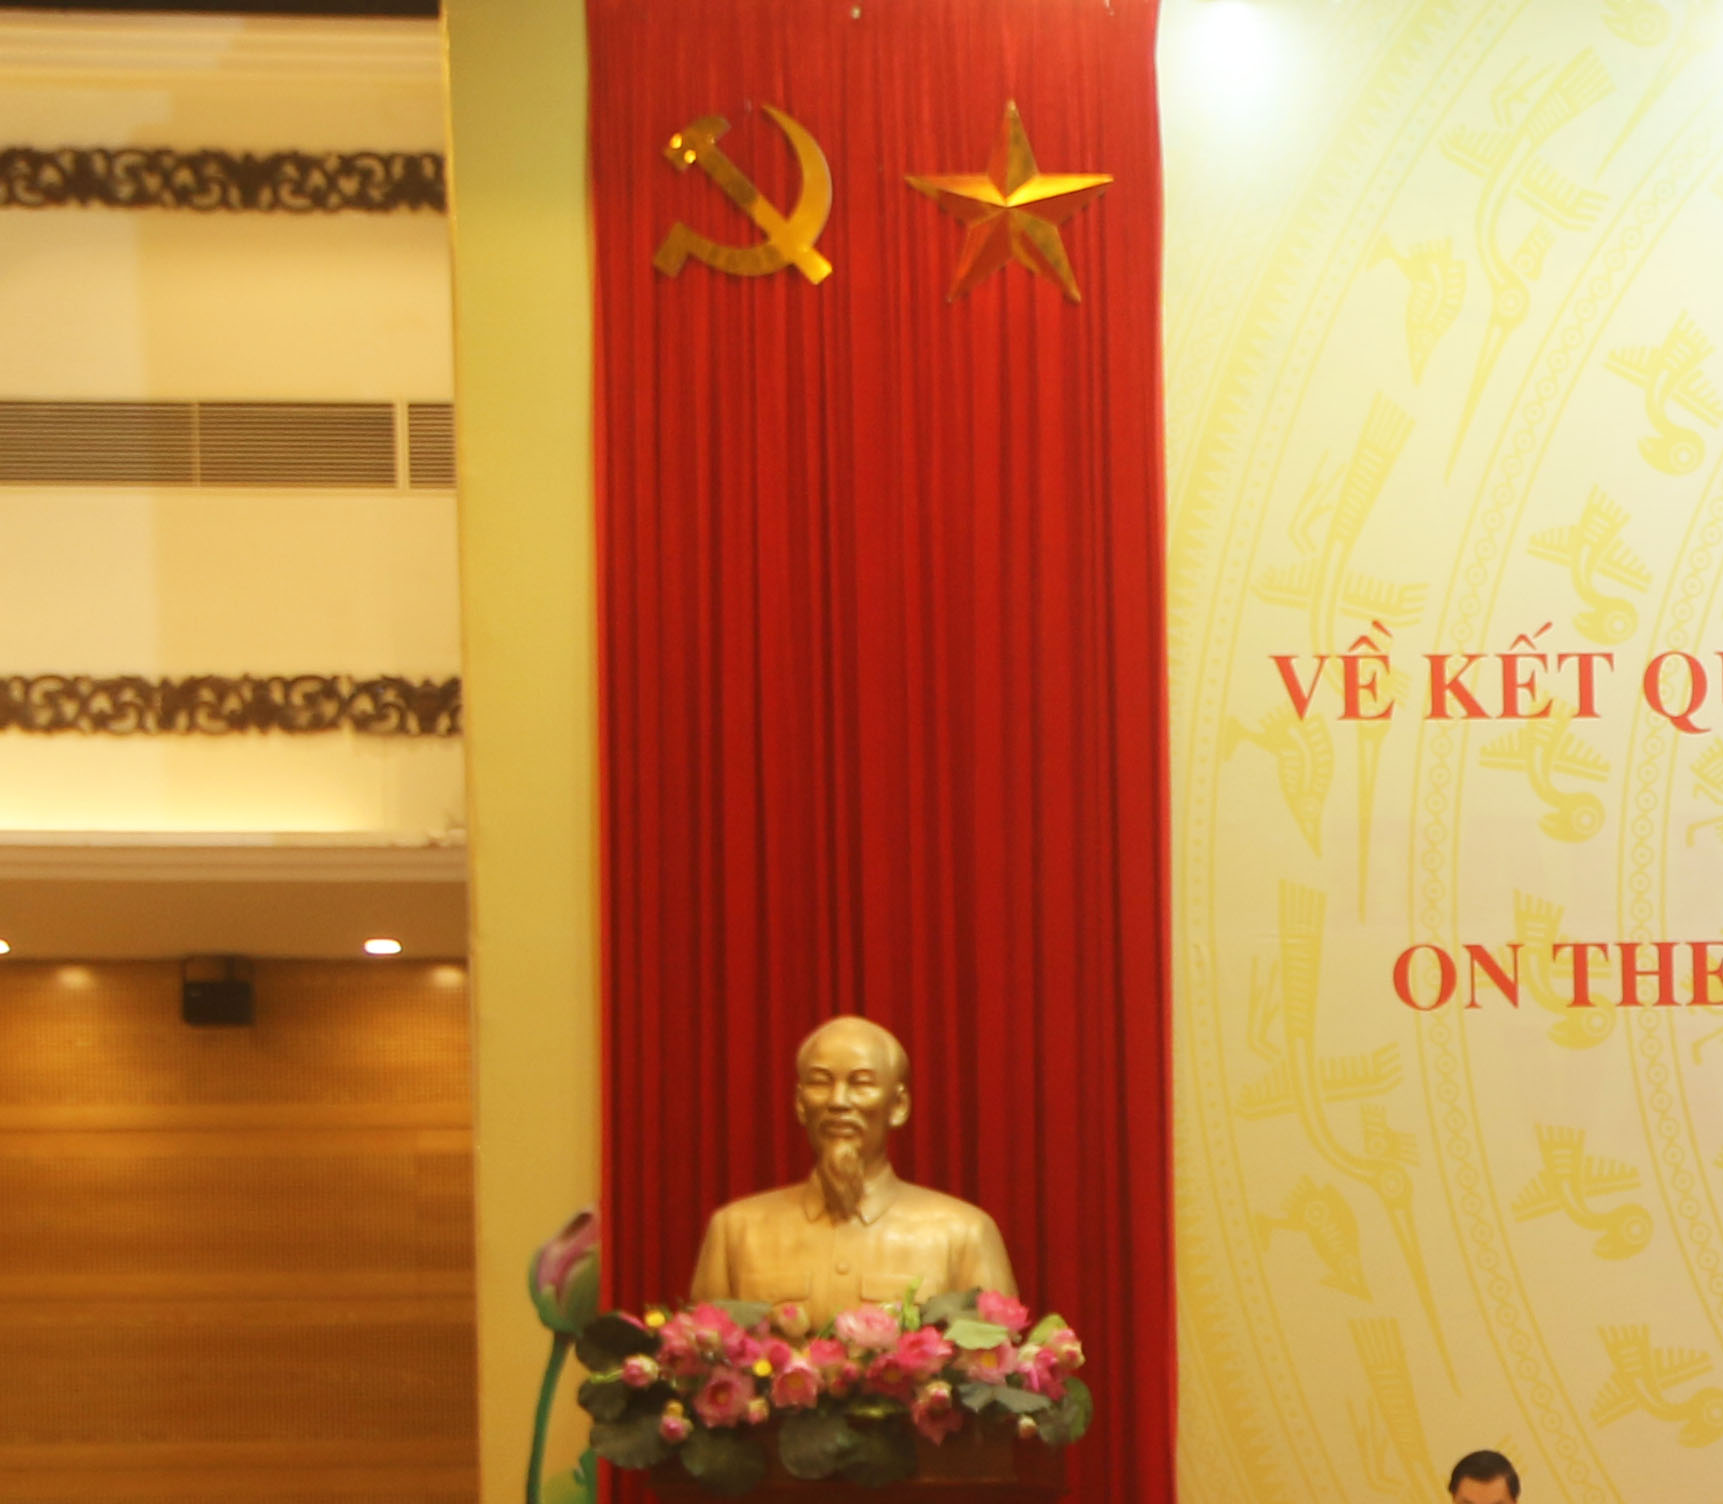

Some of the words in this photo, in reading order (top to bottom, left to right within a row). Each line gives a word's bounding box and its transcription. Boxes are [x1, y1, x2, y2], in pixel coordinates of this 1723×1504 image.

[1269, 619, 1395, 721] VỀ
[1424, 620, 1615, 720] KẾT
[1392, 943, 1523, 1011] ON
